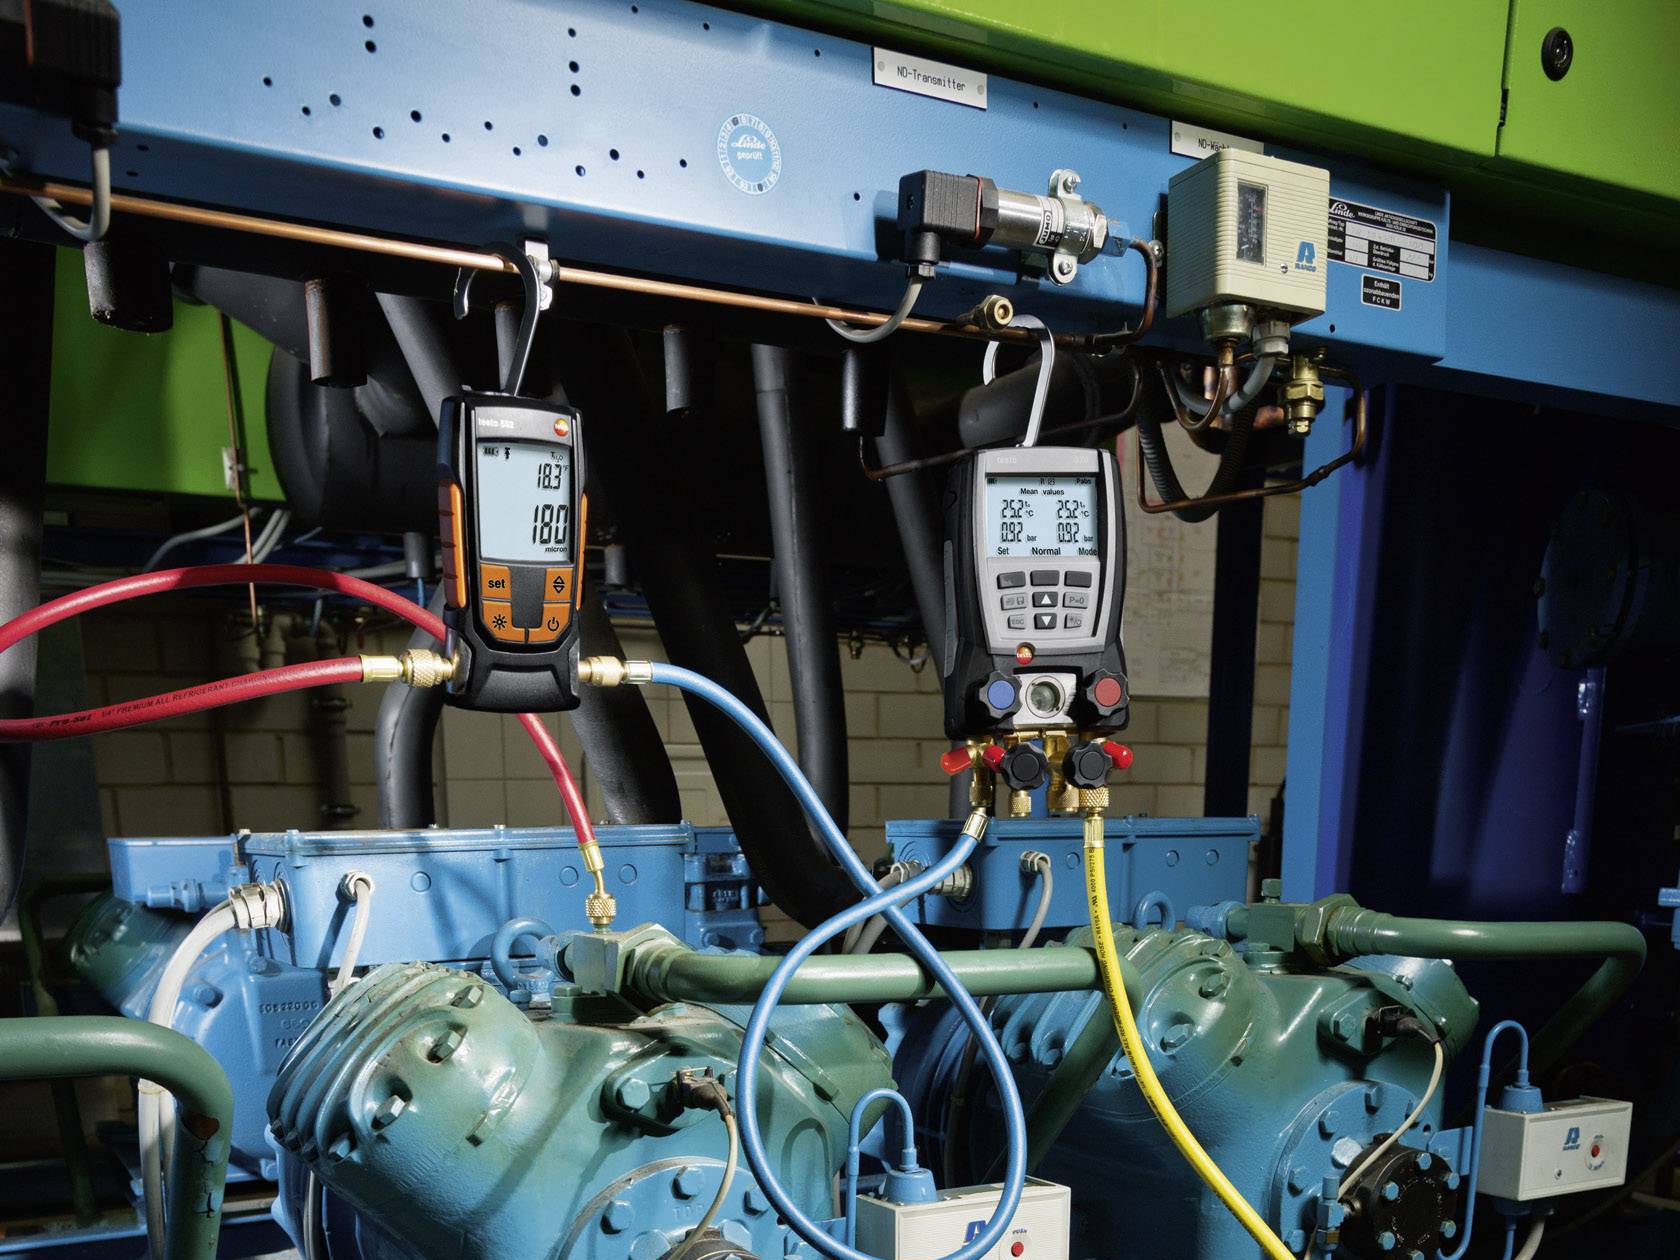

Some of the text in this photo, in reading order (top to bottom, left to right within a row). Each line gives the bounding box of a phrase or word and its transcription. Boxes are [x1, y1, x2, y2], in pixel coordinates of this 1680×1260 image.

[896, 65, 966, 91] ND-Transmitter
[1329, 201, 1355, 219] Linde
[1041, 214, 1051, 242] JUMO
[537, 463, 562, 489] 18.3
[1042, 488, 1065, 496] values
[1001, 499, 1024, 518] 25.2
[1057, 500, 1079, 518] 25.2
[532, 504, 569, 544] 180
[1084, 534, 1094, 542] bar
[997, 547, 1010, 555] Set
[1031, 547, 1061, 556] Normal
[1078, 547, 1097, 556] Mode
[488, 578, 505, 589] set
[116, 701, 154, 714] PREMIUM
[155, 697, 170, 706] ALL
[172, 683, 229, 702] REFRIGERANT
[1094, 915, 1102, 935] R410A
[1098, 941, 1106, 959] HOSE
[1102, 960, 1114, 993] CHARGING
